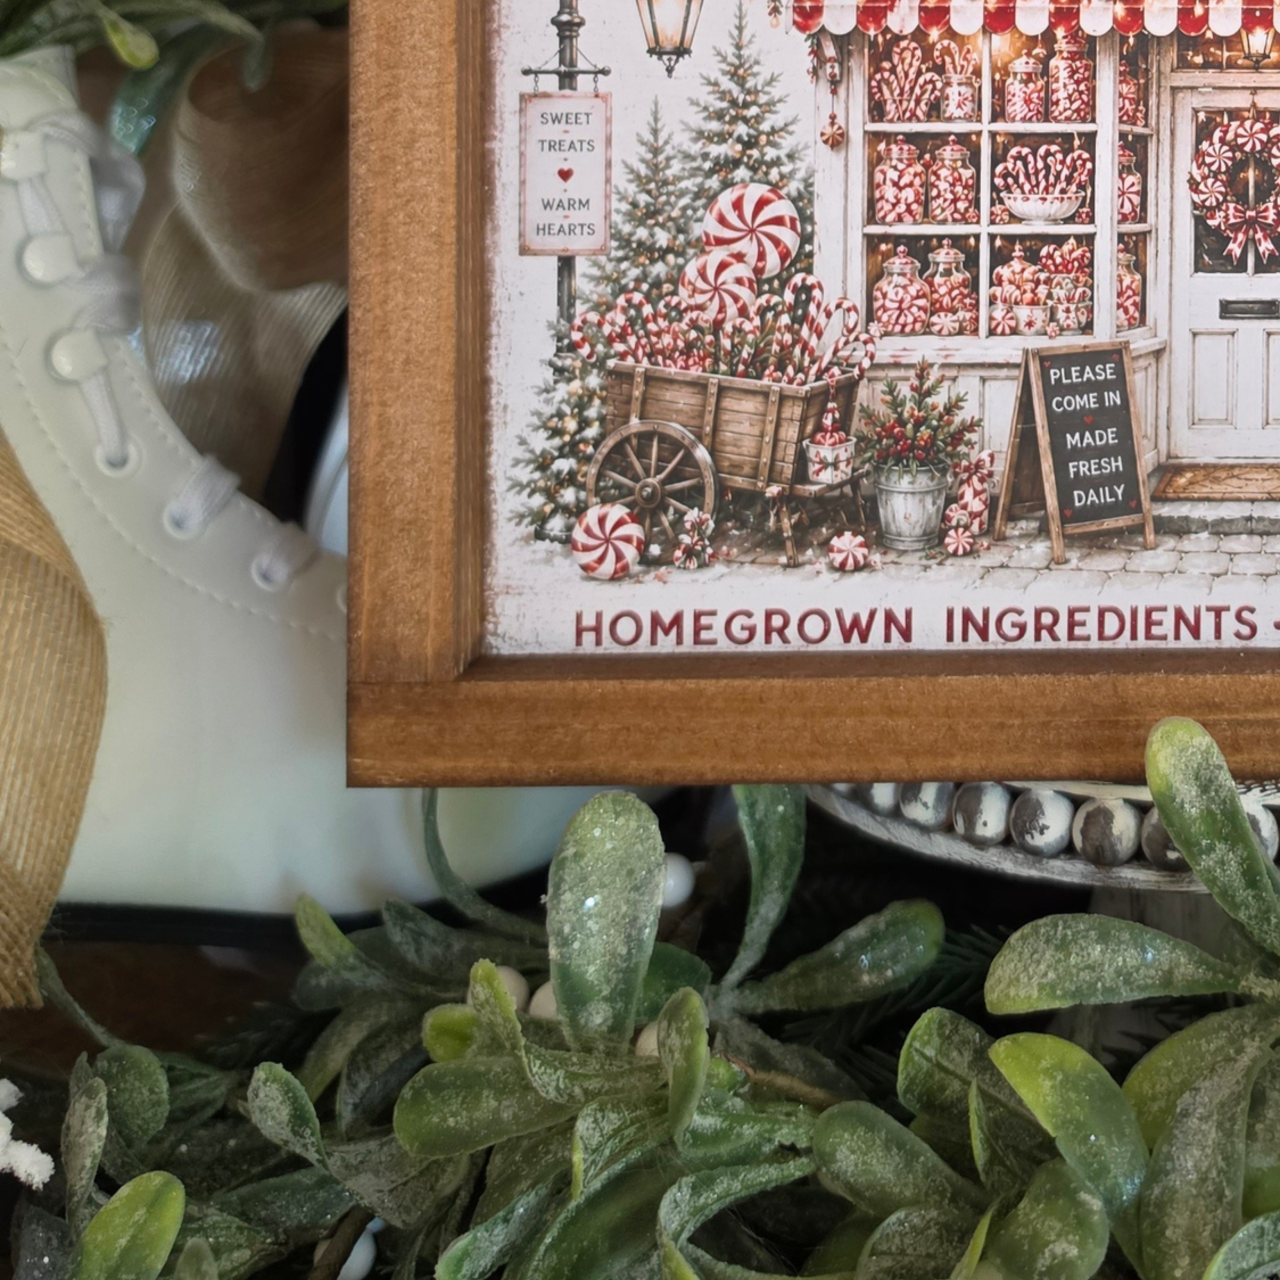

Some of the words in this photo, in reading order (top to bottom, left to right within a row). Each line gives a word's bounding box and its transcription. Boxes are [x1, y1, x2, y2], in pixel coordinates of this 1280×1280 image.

[540, 112, 593, 125] SWEET
[538, 139, 595, 152] TREATS
[541, 198, 590, 211] WARM
[536, 223, 595, 236] HEARTS
[1050, 363, 1116, 385] PLEASE
[1052, 393, 1099, 412] COME
[1104, 390, 1121, 407] IN
[1066, 428, 1118, 449] MADE
[1069, 456, 1123, 478] FRESH
[1073, 484, 1125, 507] DAILY
[575, 606, 912, 646] HOMEGROWN
[946, 604, 1257, 643] INGREDIENTS
